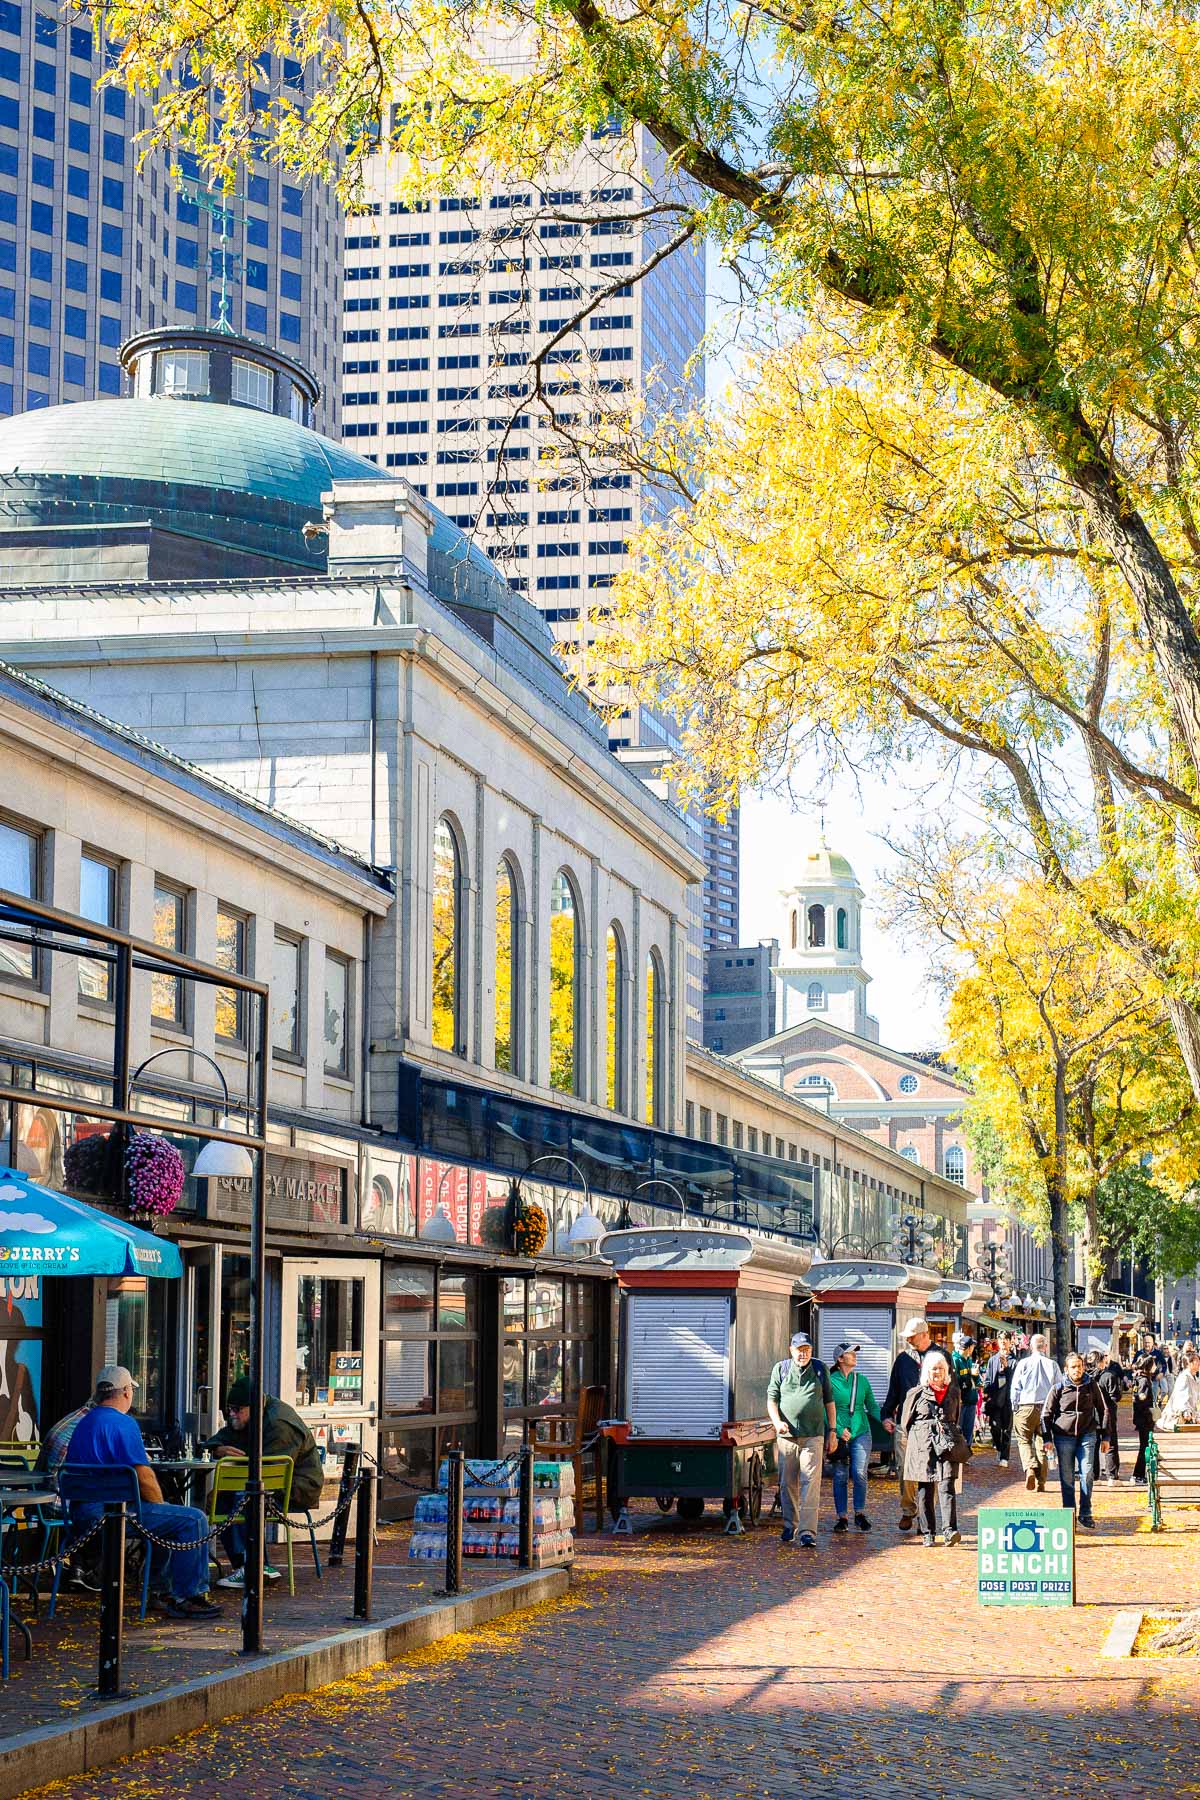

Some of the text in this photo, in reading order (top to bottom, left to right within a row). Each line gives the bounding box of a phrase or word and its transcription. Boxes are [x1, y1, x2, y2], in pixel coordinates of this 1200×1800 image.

[286, 1177, 342, 1204] MARKET
[10, 1246, 80, 1261] JERRY'S
[981, 1527, 1068, 1551] PHOTO
[981, 1553, 1068, 1574] BENCH!
[981, 1581, 1070, 1591] POSE POST PRIZE
